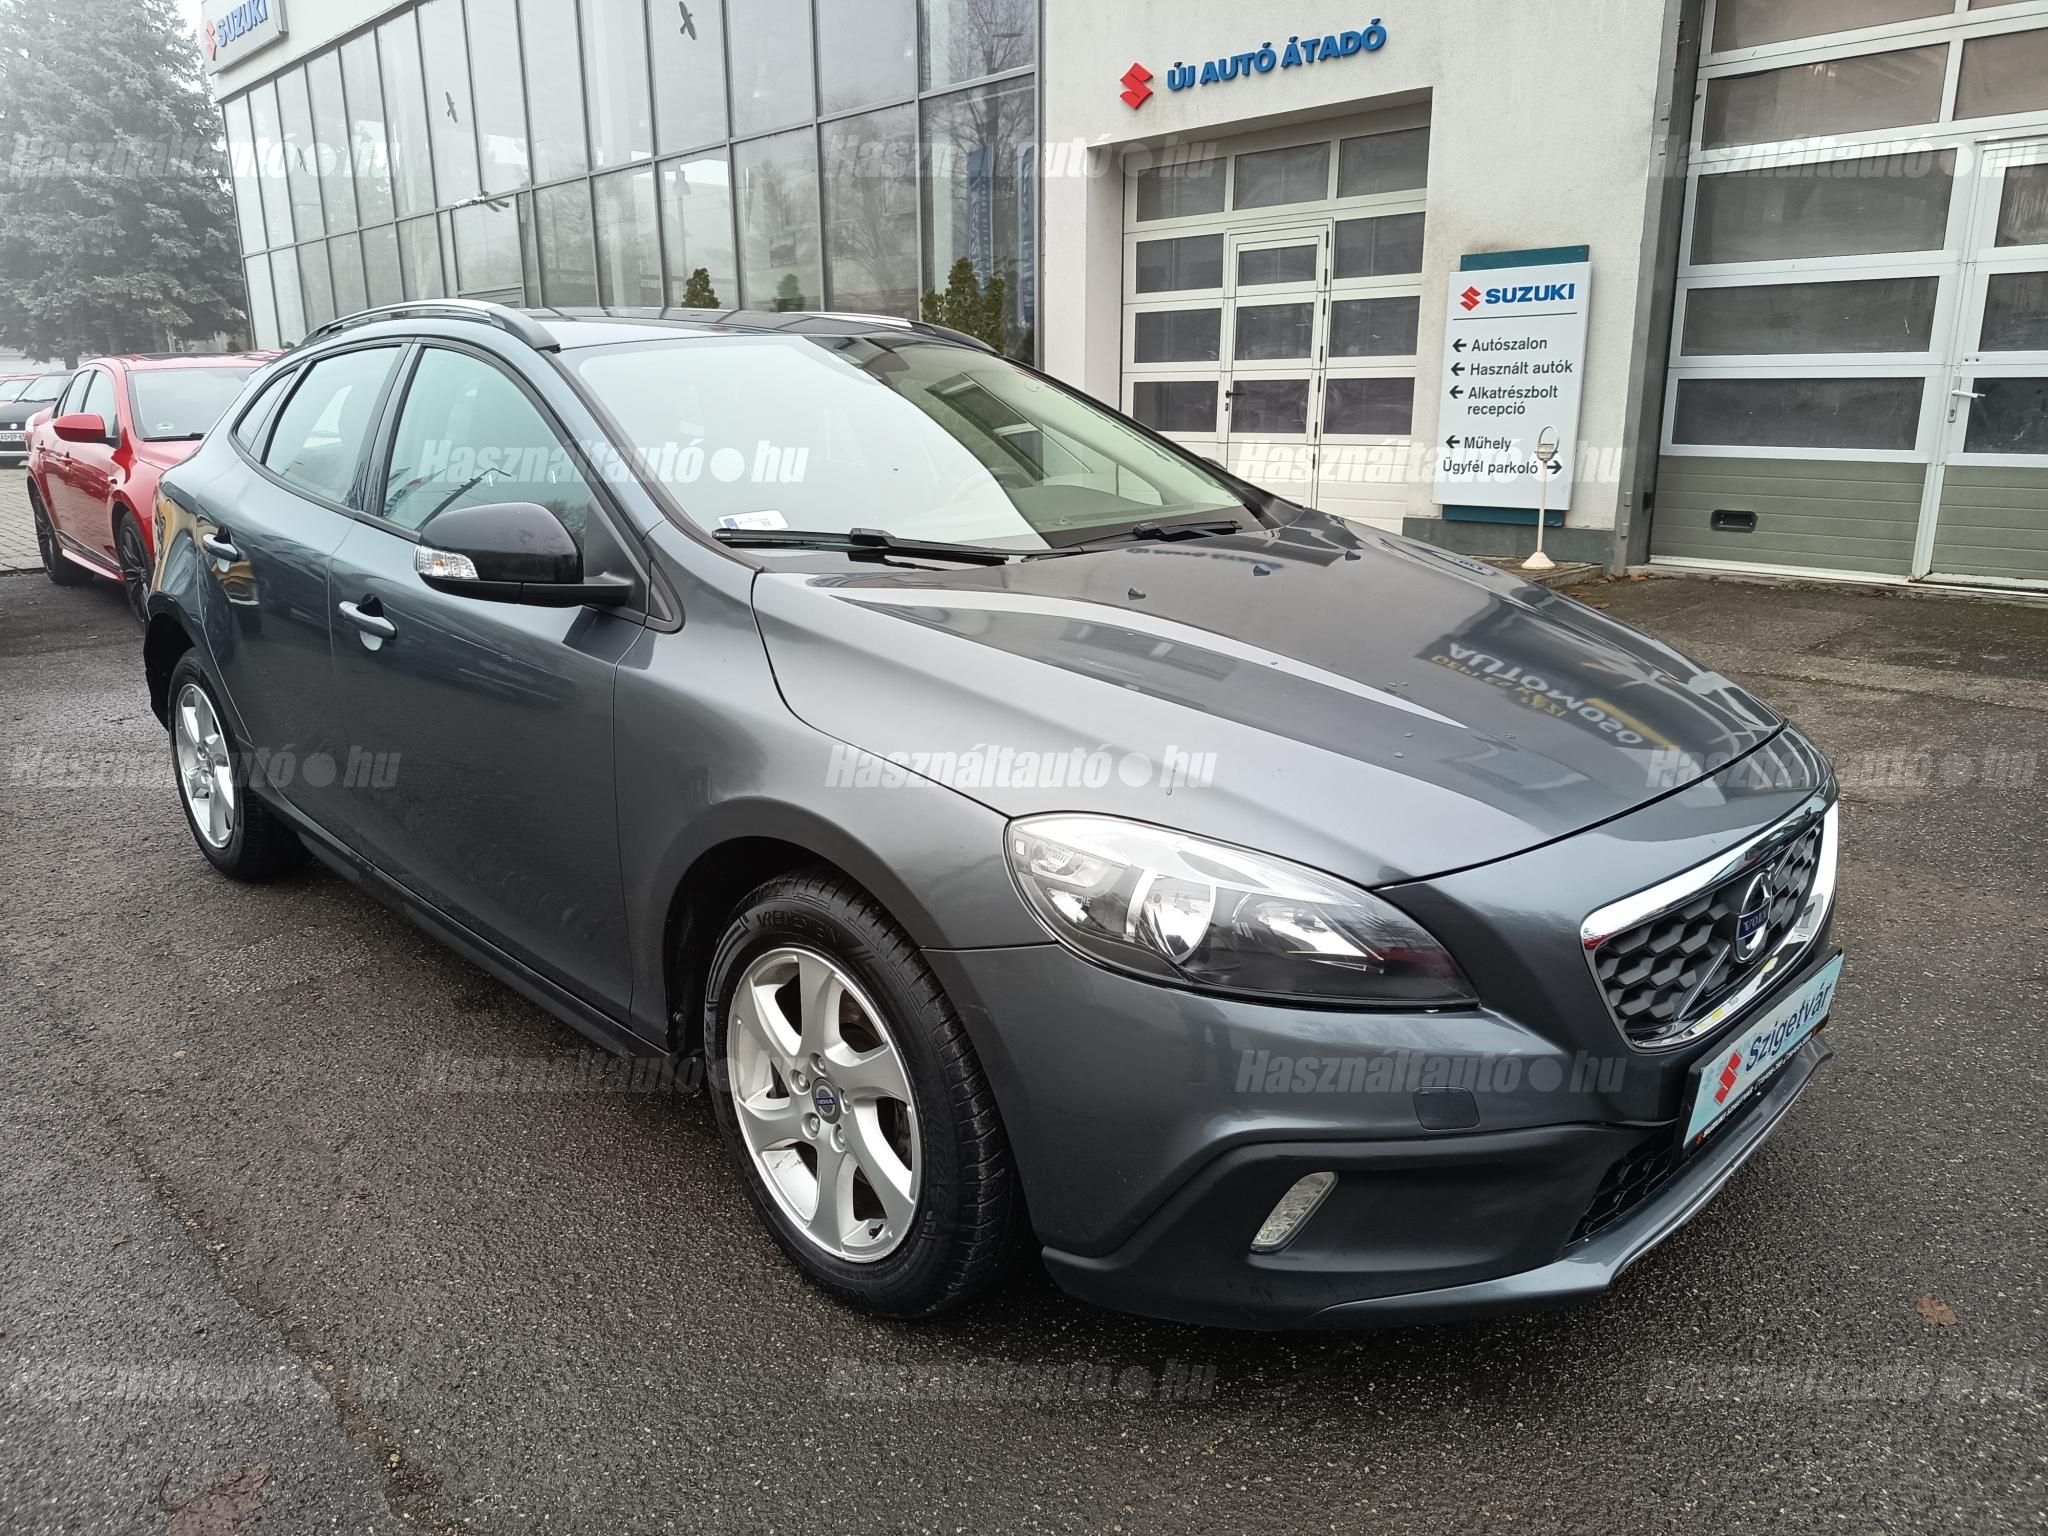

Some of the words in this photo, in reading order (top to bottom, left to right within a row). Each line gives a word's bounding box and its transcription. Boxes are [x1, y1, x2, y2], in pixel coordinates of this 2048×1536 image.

[217, 0, 268, 47] SUZUKI
[1167, 61, 1196, 91] ÚJ
[1200, 41, 1277, 86] AUTÓ
[1280, 18, 1387, 68] ÁTADÓ
[1485, 283, 1575, 304] SUZUKI
[1471, 337, 1547, 352] Autószalon
[1470, 361, 1529, 376] Használt
[1532, 360, 1573, 374] autók
[1468, 385, 1558, 399] Alkatrészbolt
[1467, 401, 1526, 417] recepció
[1464, 436, 1512, 452] Műhely
[1443, 457, 1484, 475] Ügyfél
[1487, 461, 1538, 475] parkoló
[1743, 907, 1768, 931] VOLV
[1746, 983, 1832, 1072] Szigetvár
